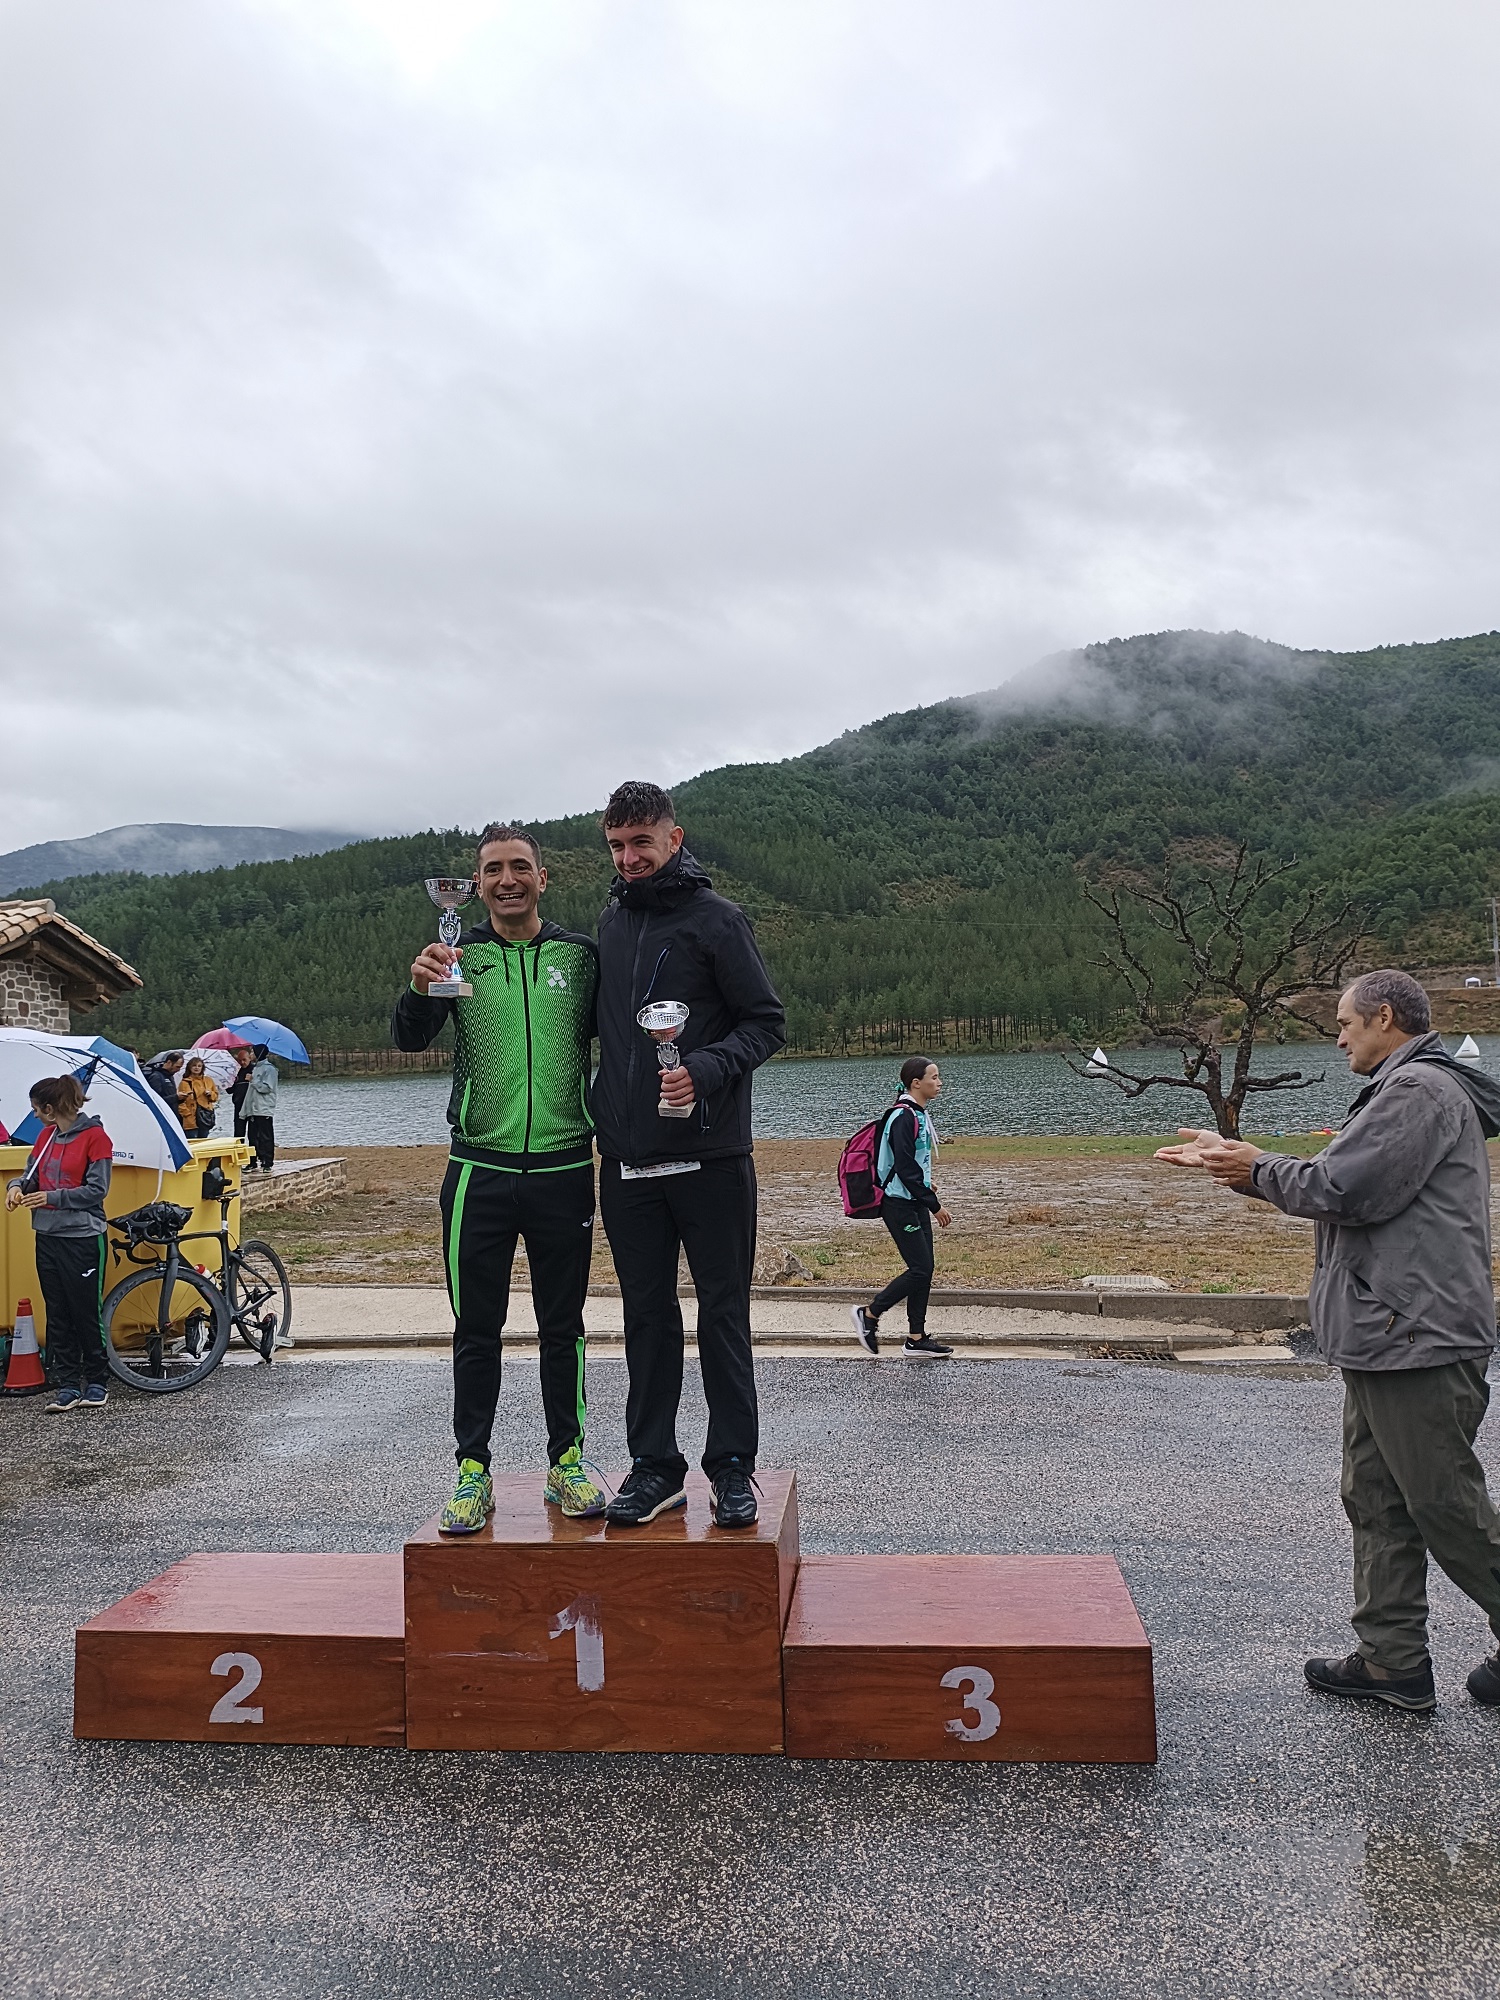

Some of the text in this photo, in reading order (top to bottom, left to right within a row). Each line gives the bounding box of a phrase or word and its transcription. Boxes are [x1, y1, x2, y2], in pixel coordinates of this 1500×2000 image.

[548, 1595, 605, 1692] 1
[209, 1653, 264, 1724] 2
[940, 1666, 1001, 1742] 3
